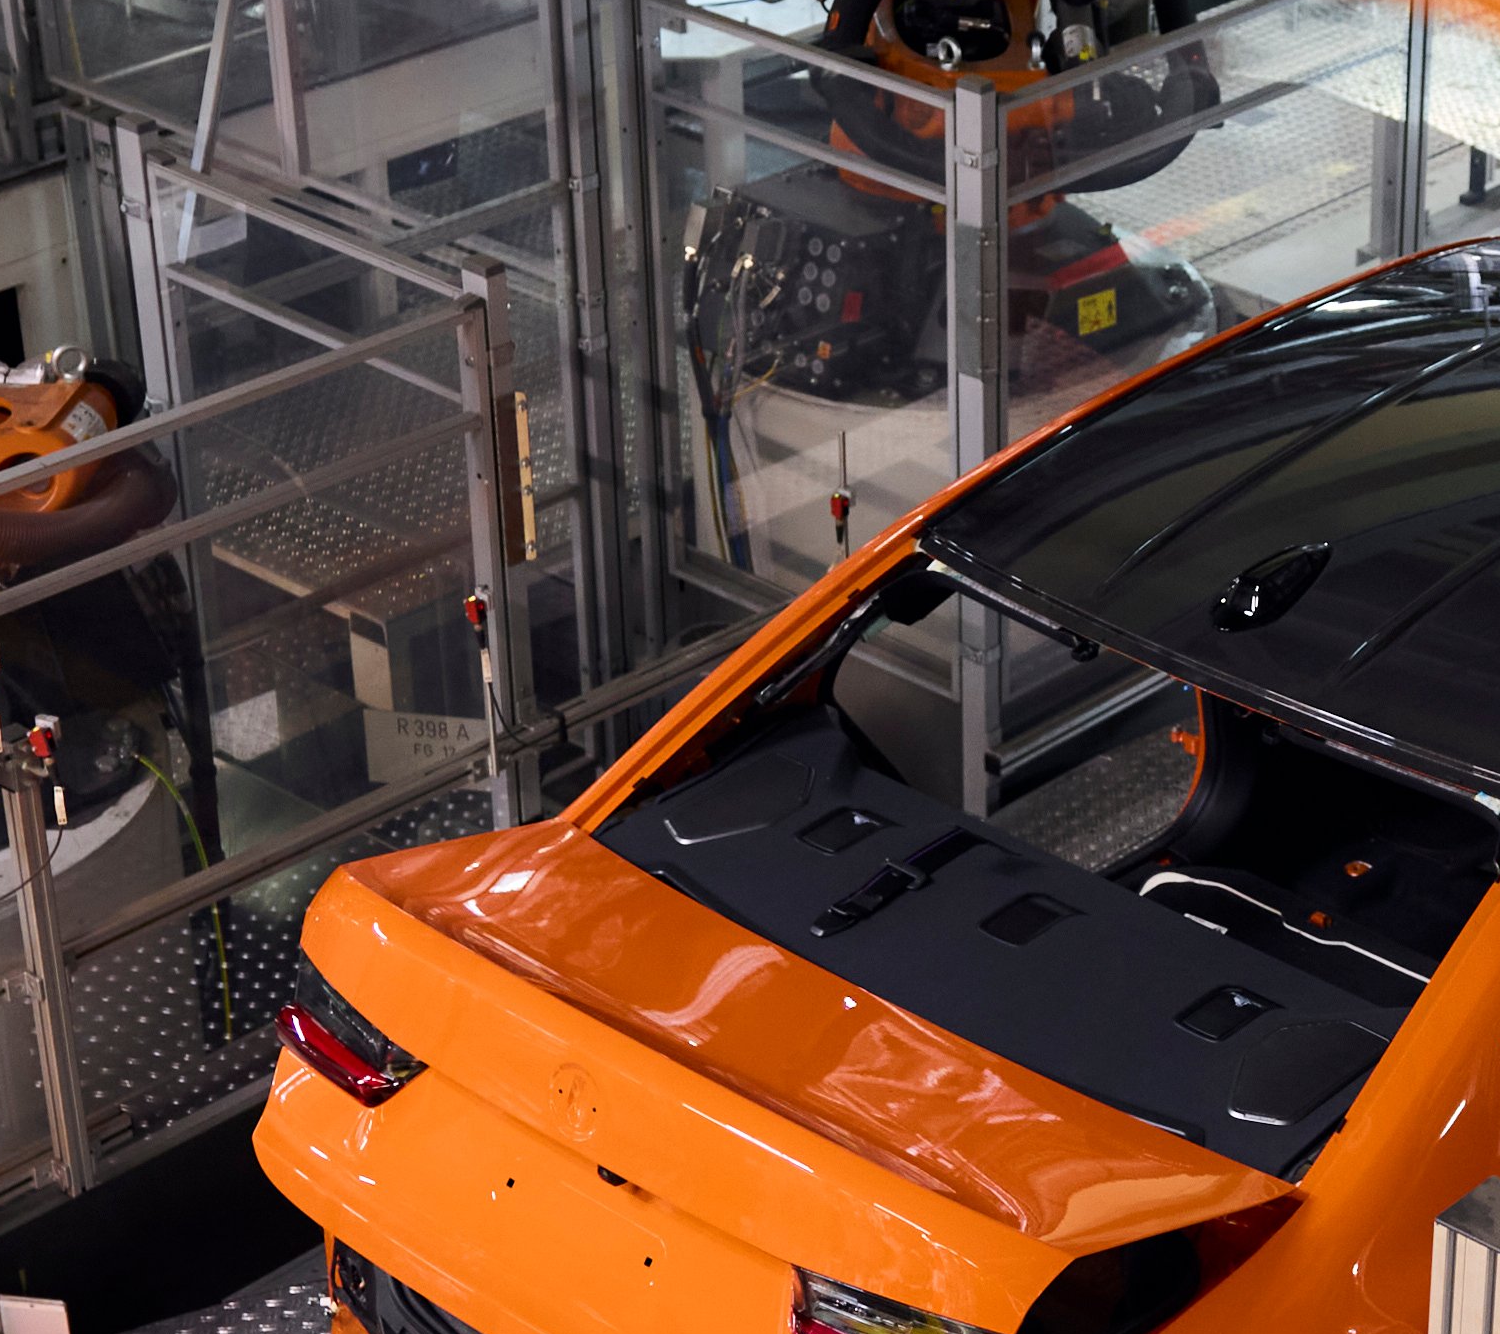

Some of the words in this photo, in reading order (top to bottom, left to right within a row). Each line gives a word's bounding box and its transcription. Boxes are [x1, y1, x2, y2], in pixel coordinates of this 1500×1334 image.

[397, 718, 409, 736] R
[414, 719, 448, 739] 398
[457, 723, 470, 741] A
[414, 743, 434, 757] FG
